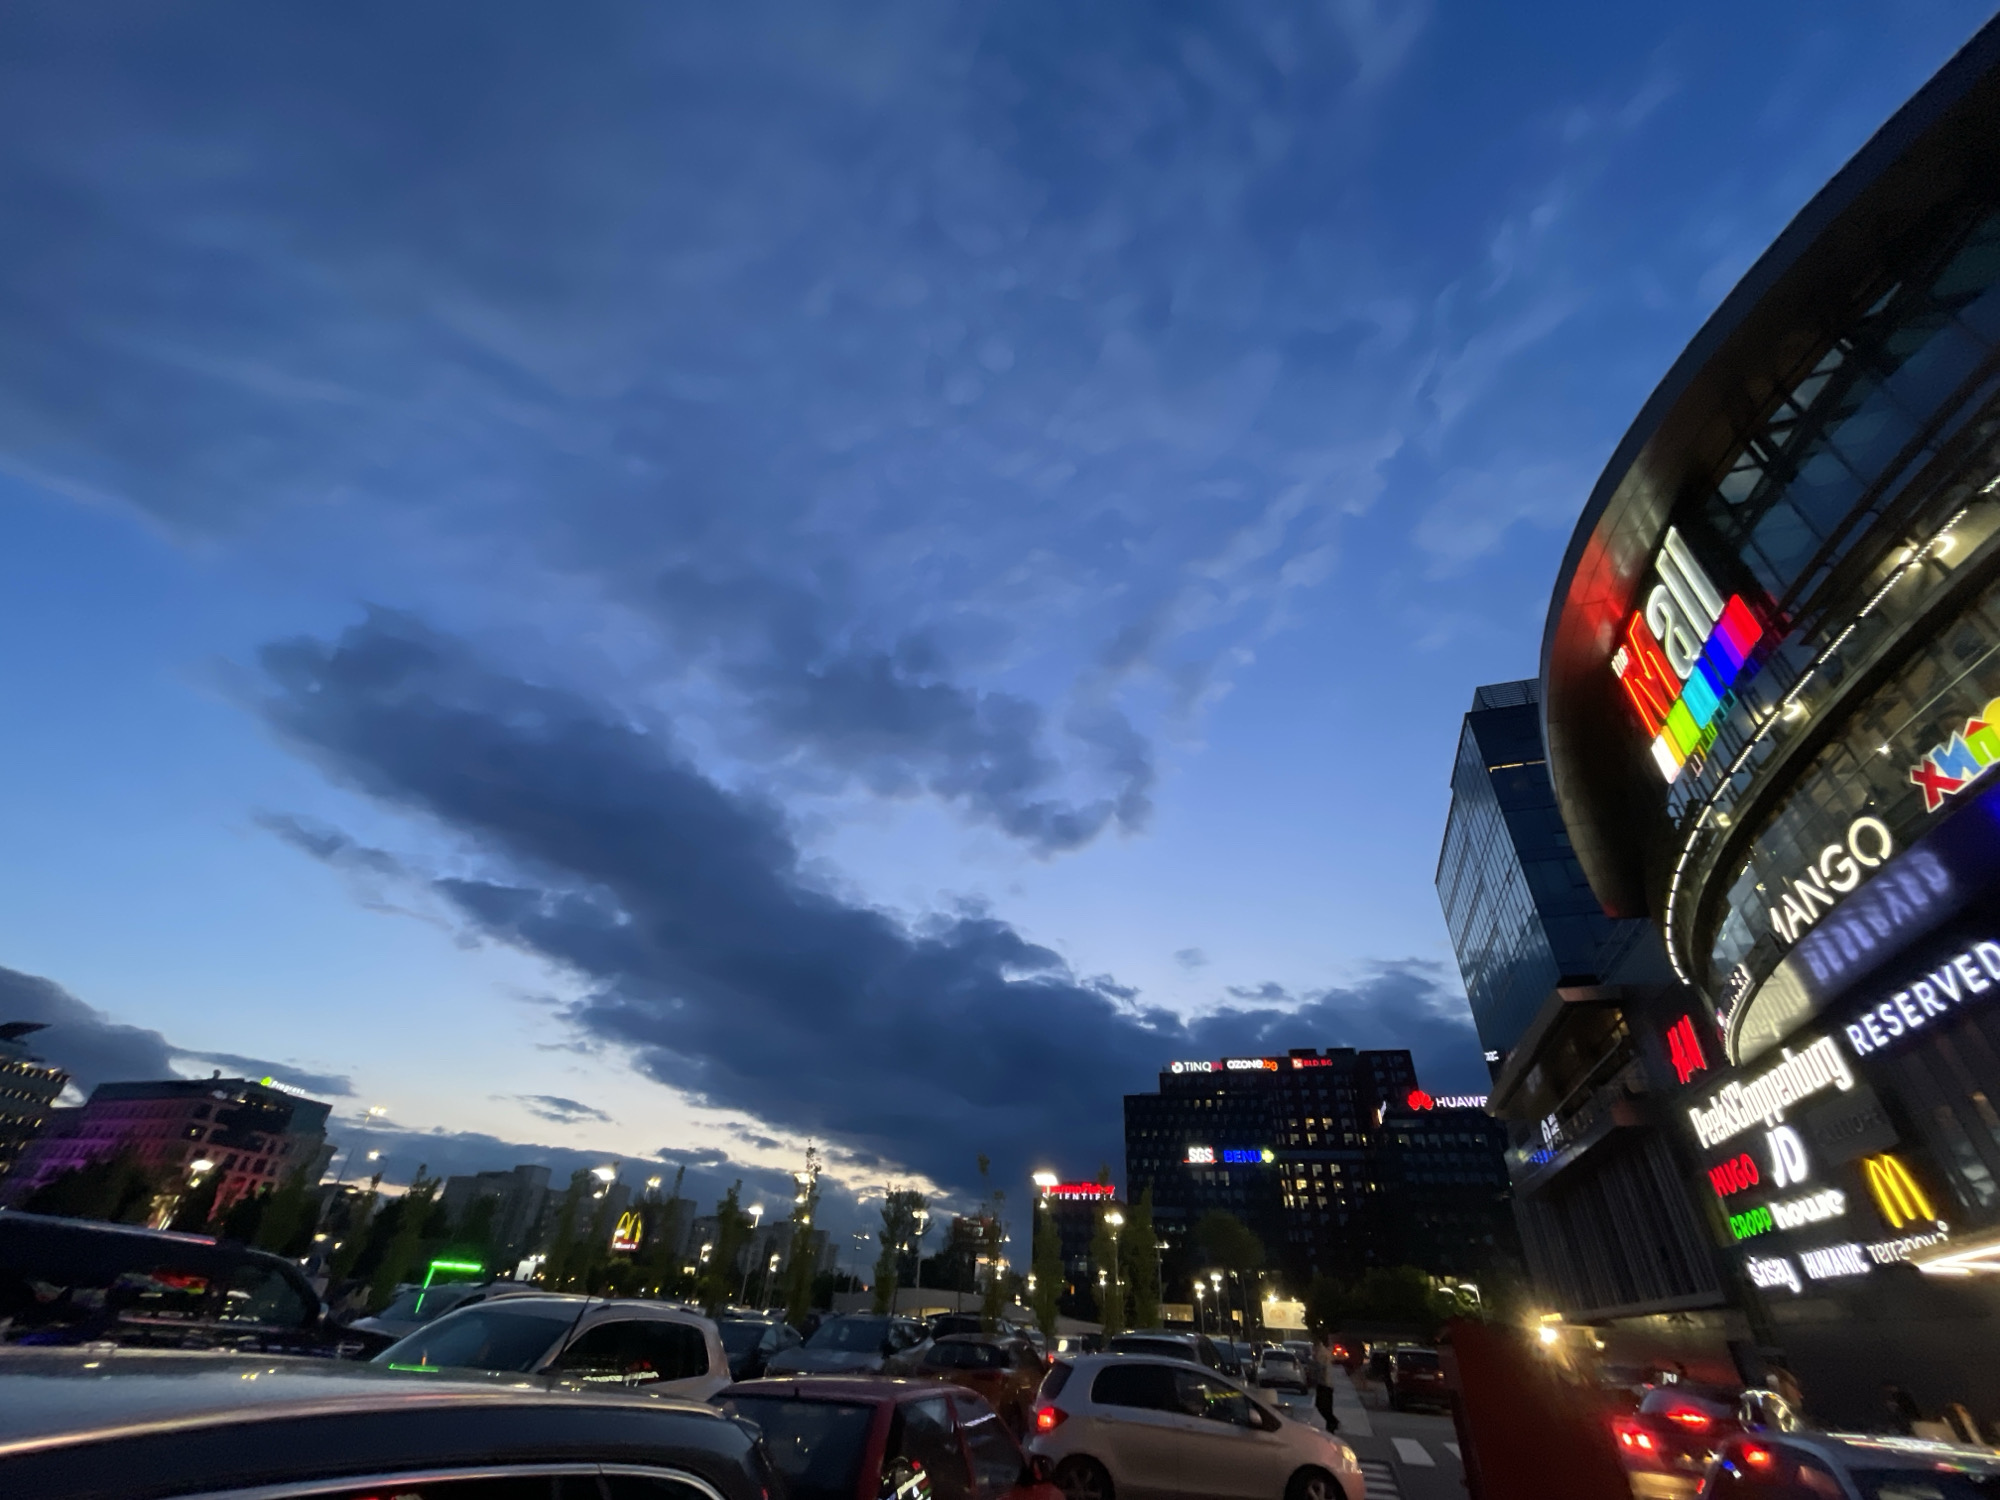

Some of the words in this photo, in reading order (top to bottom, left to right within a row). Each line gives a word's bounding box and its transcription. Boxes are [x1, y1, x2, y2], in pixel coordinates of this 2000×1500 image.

[1623, 526, 1725, 738] Mall
[1846, 942, 2000, 1056] RESERVED
[1188, 1147, 1213, 1163] SGS
[1223, 1150, 1262, 1163] BENU
[1766, 1126, 1808, 1187] JD
[1708, 1154, 1759, 1197] HUGO
[1730, 1207, 1772, 1239] CROPP
[1748, 1256, 1802, 1293] sinsay
[1801, 1244, 1870, 1280] HUMANIC
